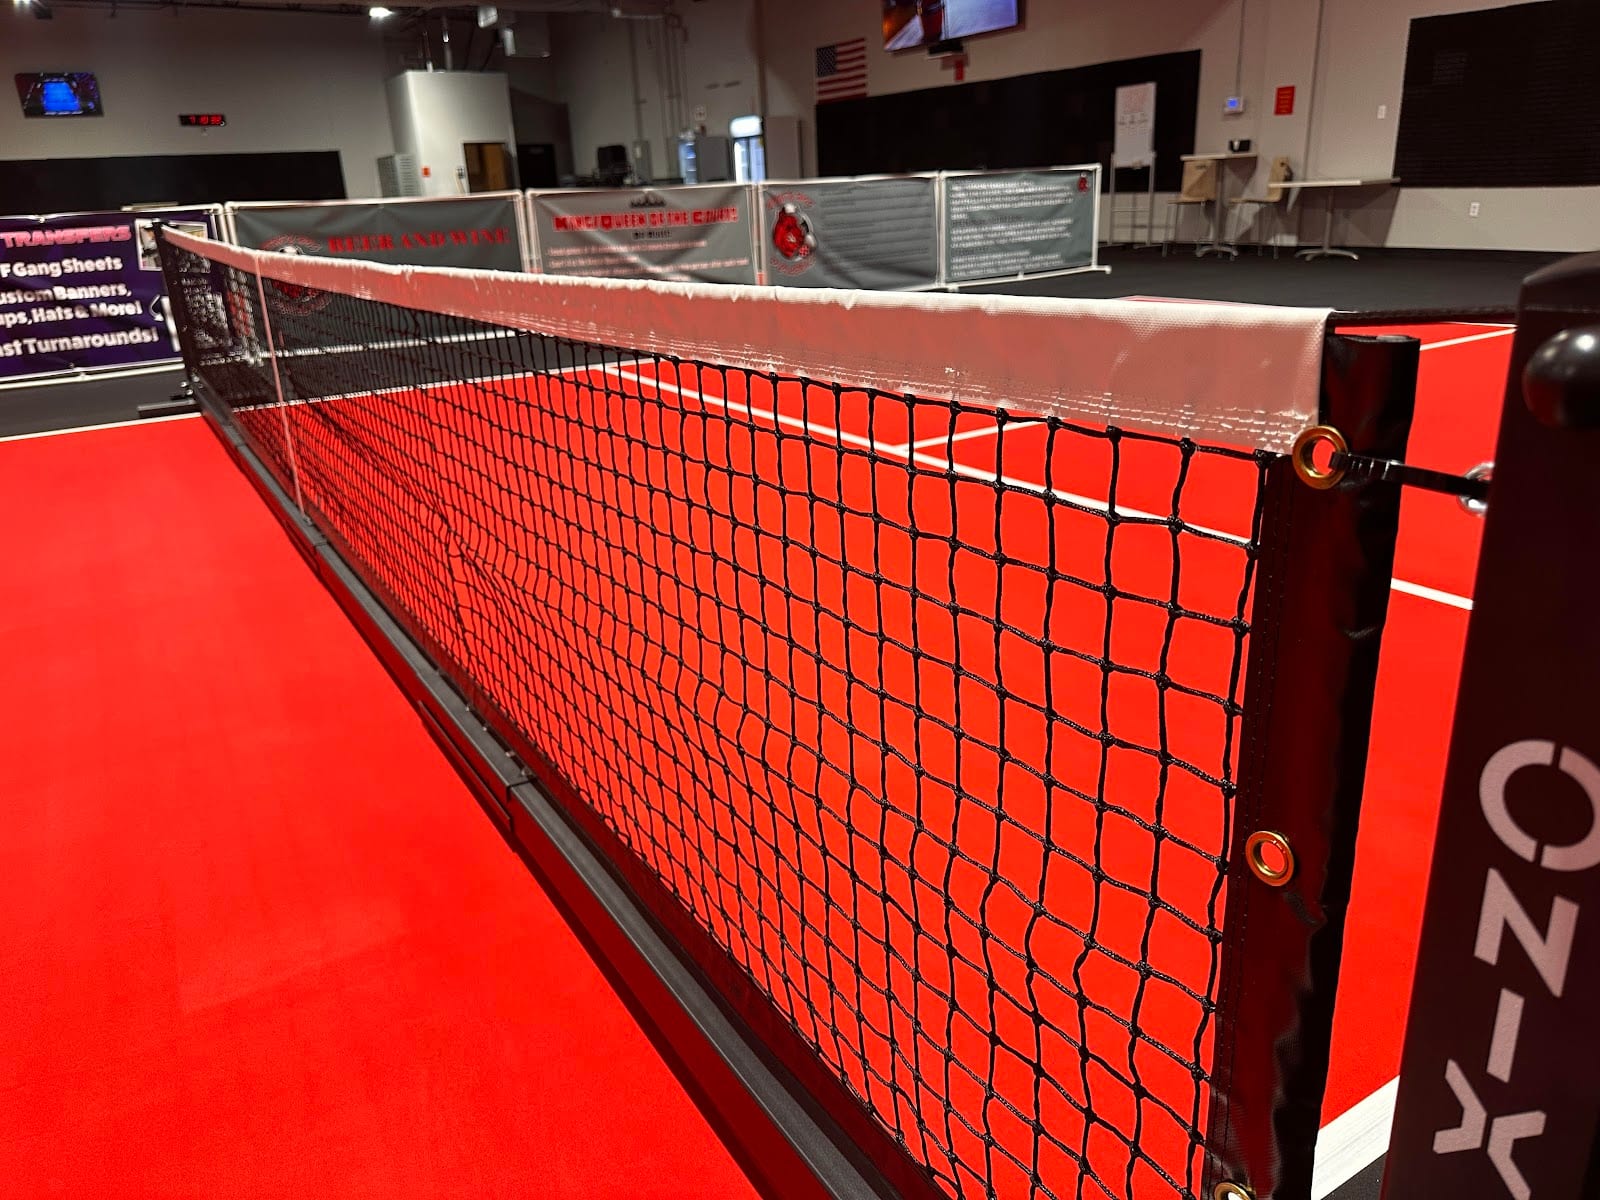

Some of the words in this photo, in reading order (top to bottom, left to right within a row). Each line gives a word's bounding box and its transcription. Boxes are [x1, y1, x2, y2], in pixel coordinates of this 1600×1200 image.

[328, 234, 394, 253] BEER
[400, 230, 446, 250] AND
[449, 226, 511, 247] WINE
[13, 262, 61, 277] Gang
[62, 257, 122, 273] Sheets
[0, 288, 54, 306] ustom
[52, 283, 132, 300] Banners,
[0, 310, 33, 329] ps,
[32, 307, 73, 323] Hats
[75, 305, 89, 319] &
[91, 301, 142, 317] More!
[0, 338, 23, 358] st
[22, 326, 159, 355] Turnarounds!
